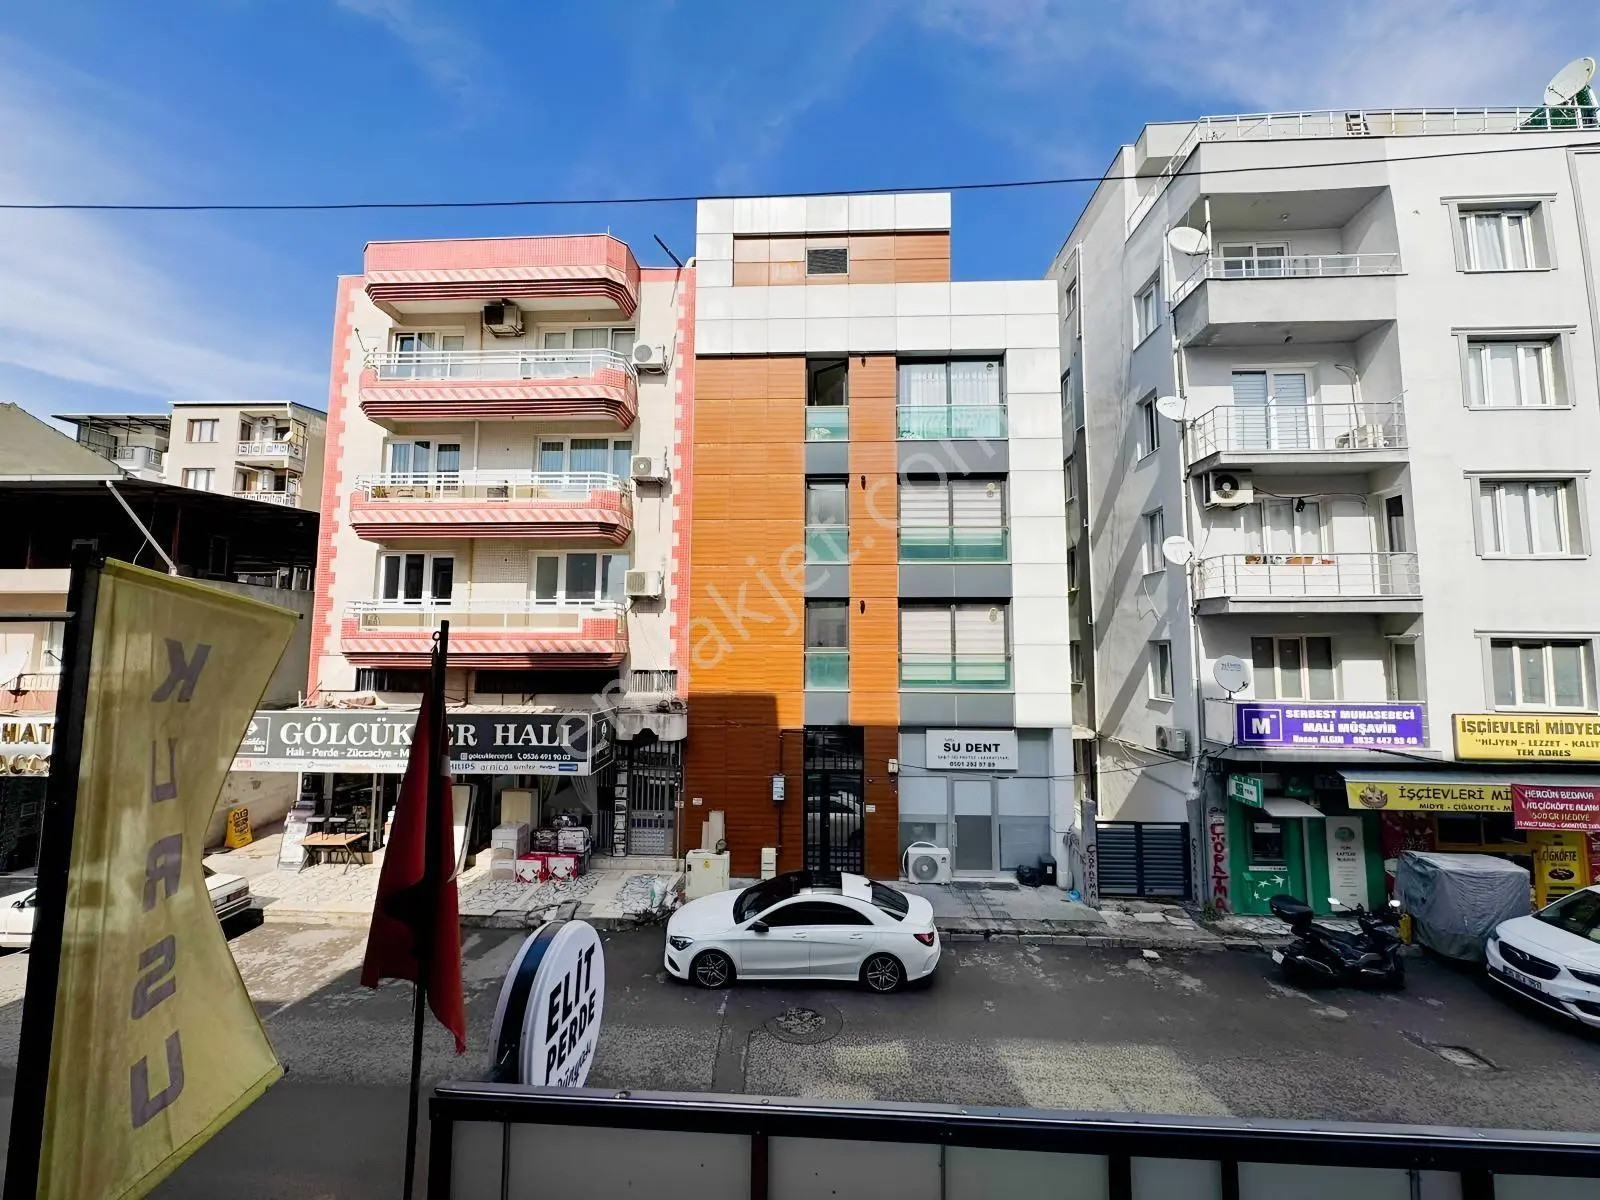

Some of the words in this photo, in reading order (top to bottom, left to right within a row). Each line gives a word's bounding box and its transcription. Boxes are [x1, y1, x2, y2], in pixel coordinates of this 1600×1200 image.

[1286, 709, 1337, 719] SERBEST
[1461, 718, 1540, 735] İŞÇİEVLERİ
[943, 742, 961, 752] SU
[965, 743, 1001, 752] DENT
[1398, 786, 1485, 801] İŞÇİEVLERİ
[545, 942, 596, 1046] ELİT
[545, 988, 597, 1086] PERDE
